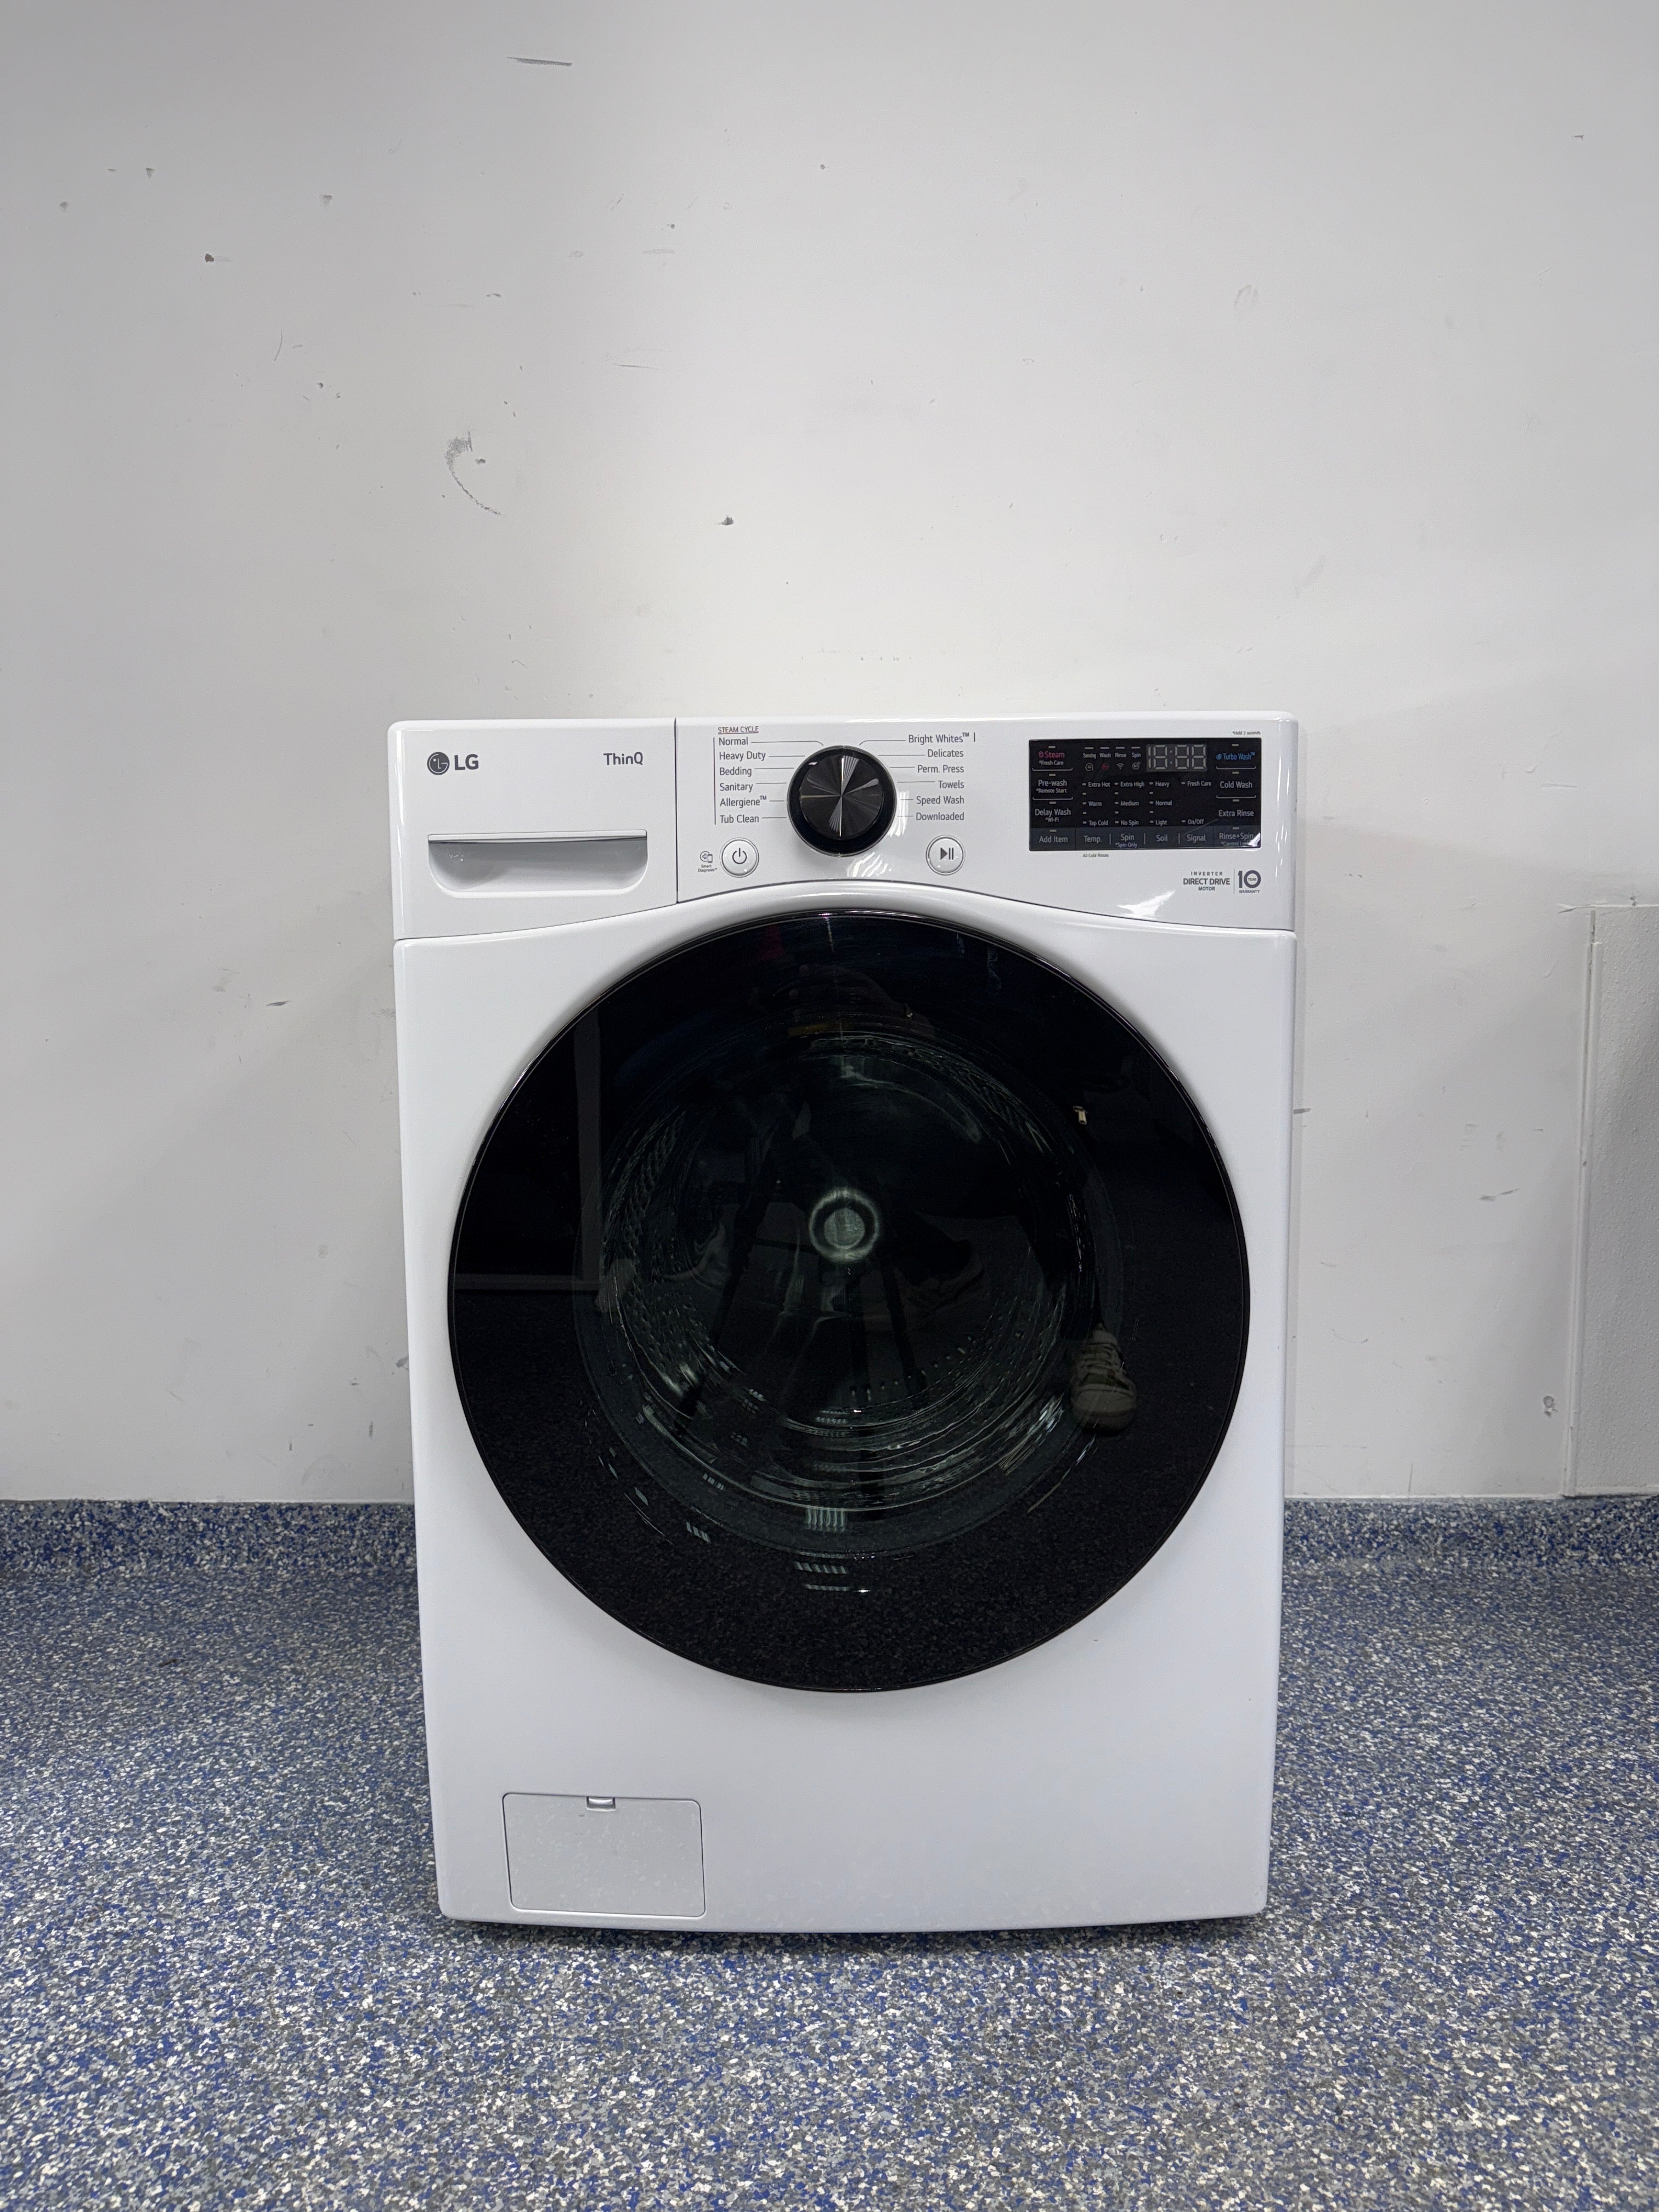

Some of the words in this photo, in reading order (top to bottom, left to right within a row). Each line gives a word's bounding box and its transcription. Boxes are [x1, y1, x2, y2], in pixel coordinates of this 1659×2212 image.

[719, 737, 748, 746] Normal
[909, 734, 933, 745] Bright
[719, 752, 744, 761] Heavy
[747, 751, 766, 761] Duty
[927, 749, 964, 758] Delicates
[454, 754, 479, 770] LG
[603, 752, 643, 765] ThinQ
[719, 767, 752, 777] Bedding
[917, 765, 940, 773] Perm.
[943, 765, 964, 773] Press
[720, 782, 753, 793] Sanitary
[938, 780, 964, 789] Towels
[916, 796, 940, 806] Speed
[944, 796, 964, 804] Wash
[916, 812, 964, 821] Downloaded
[1035, 809, 1052, 817] Delay
[720, 815, 733, 823] Tub
[737, 814, 759, 823] Clean
[1084, 835, 1102, 843] Temp.
[1120, 834, 1135, 842] Spin
[1187, 834, 1206, 843] Signal
[1219, 832, 1254, 841] Rinse+Spin
[1238, 870, 1261, 888] 10
